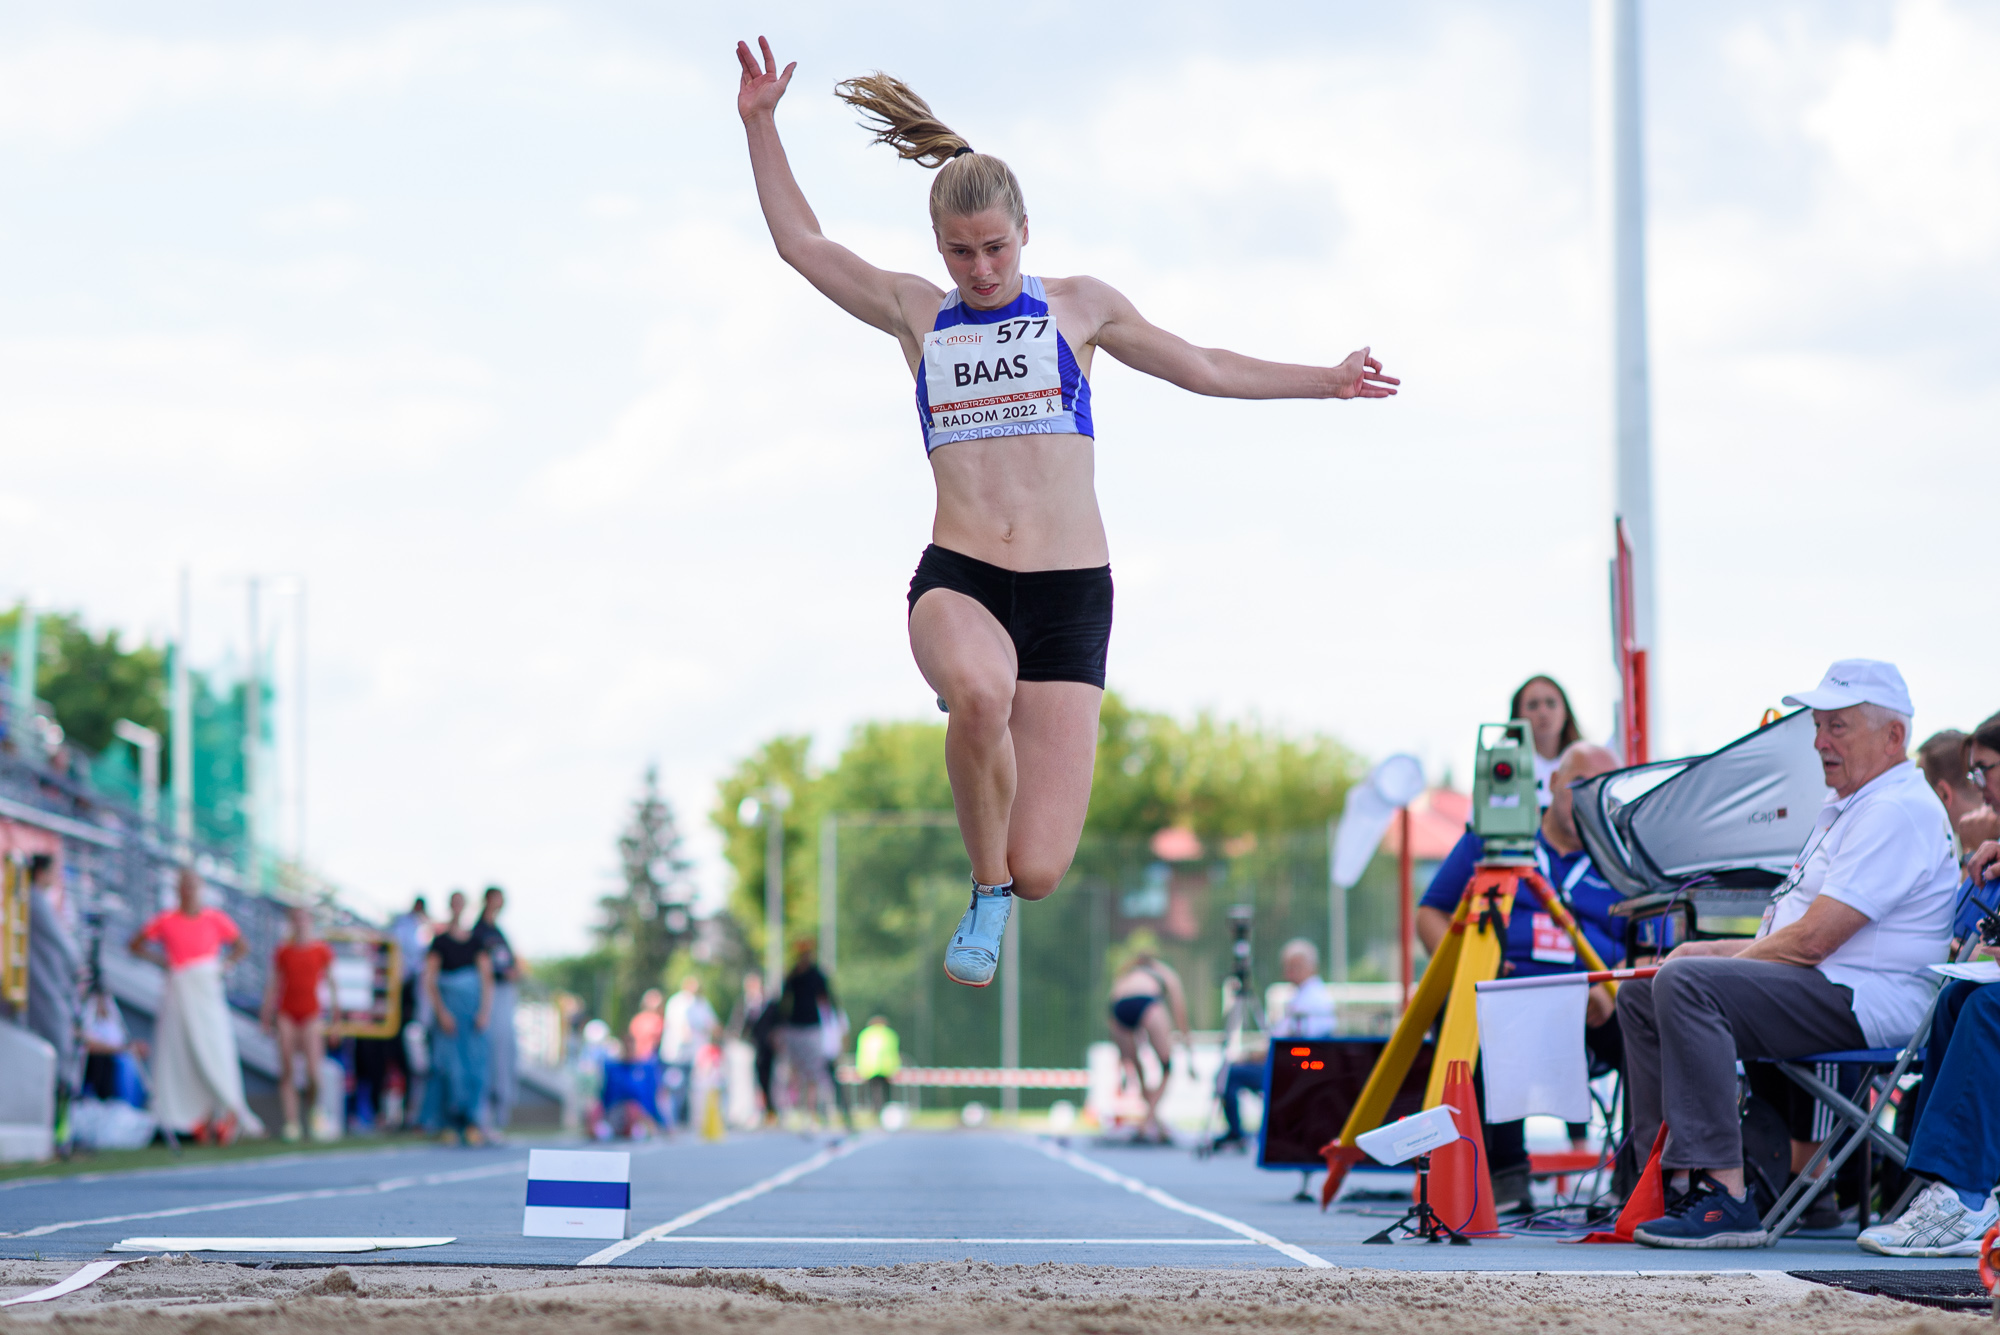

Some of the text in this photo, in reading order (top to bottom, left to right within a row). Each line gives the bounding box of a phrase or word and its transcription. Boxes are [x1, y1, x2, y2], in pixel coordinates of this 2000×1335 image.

[946, 332, 984, 344] mosir
[996, 319, 1049, 344] 577
[954, 354, 1028, 387] BAAS
[933, 388, 1059, 412] PZLA MISTRZOSTWA POLSKI U20
[942, 404, 1038, 428] RADOM 2022
[950, 421, 1051, 442] AZS POZNAŃ
[1748, 811, 1776, 824] iCap
[977, 885, 993, 893] NIKE
